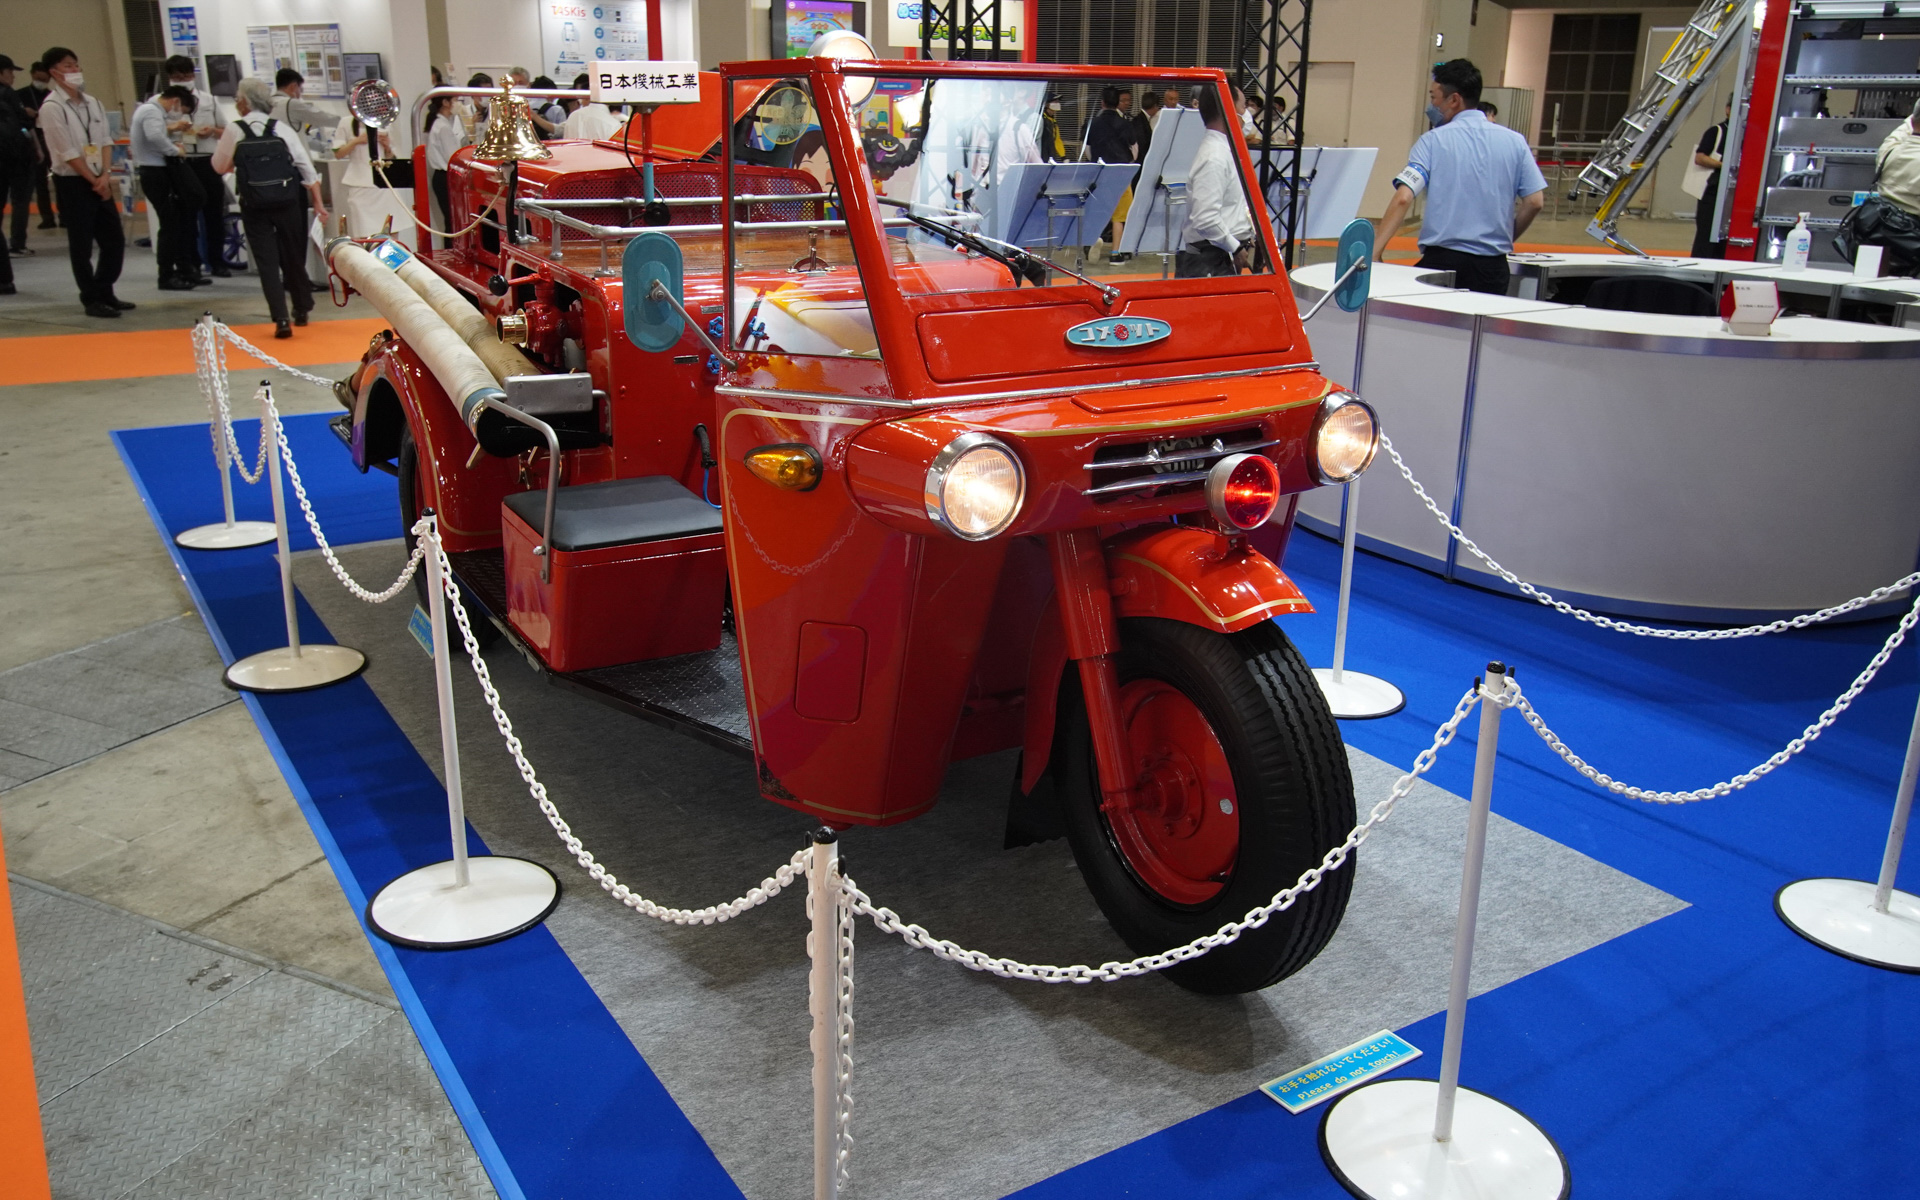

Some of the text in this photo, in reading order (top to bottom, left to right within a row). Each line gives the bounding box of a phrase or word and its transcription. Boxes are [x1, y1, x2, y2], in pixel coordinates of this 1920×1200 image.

[552, 5, 586, 17] TASKis
[600, 73, 697, 90] 日本機械工業
[1298, 1051, 1400, 1100] Please do not touch!
